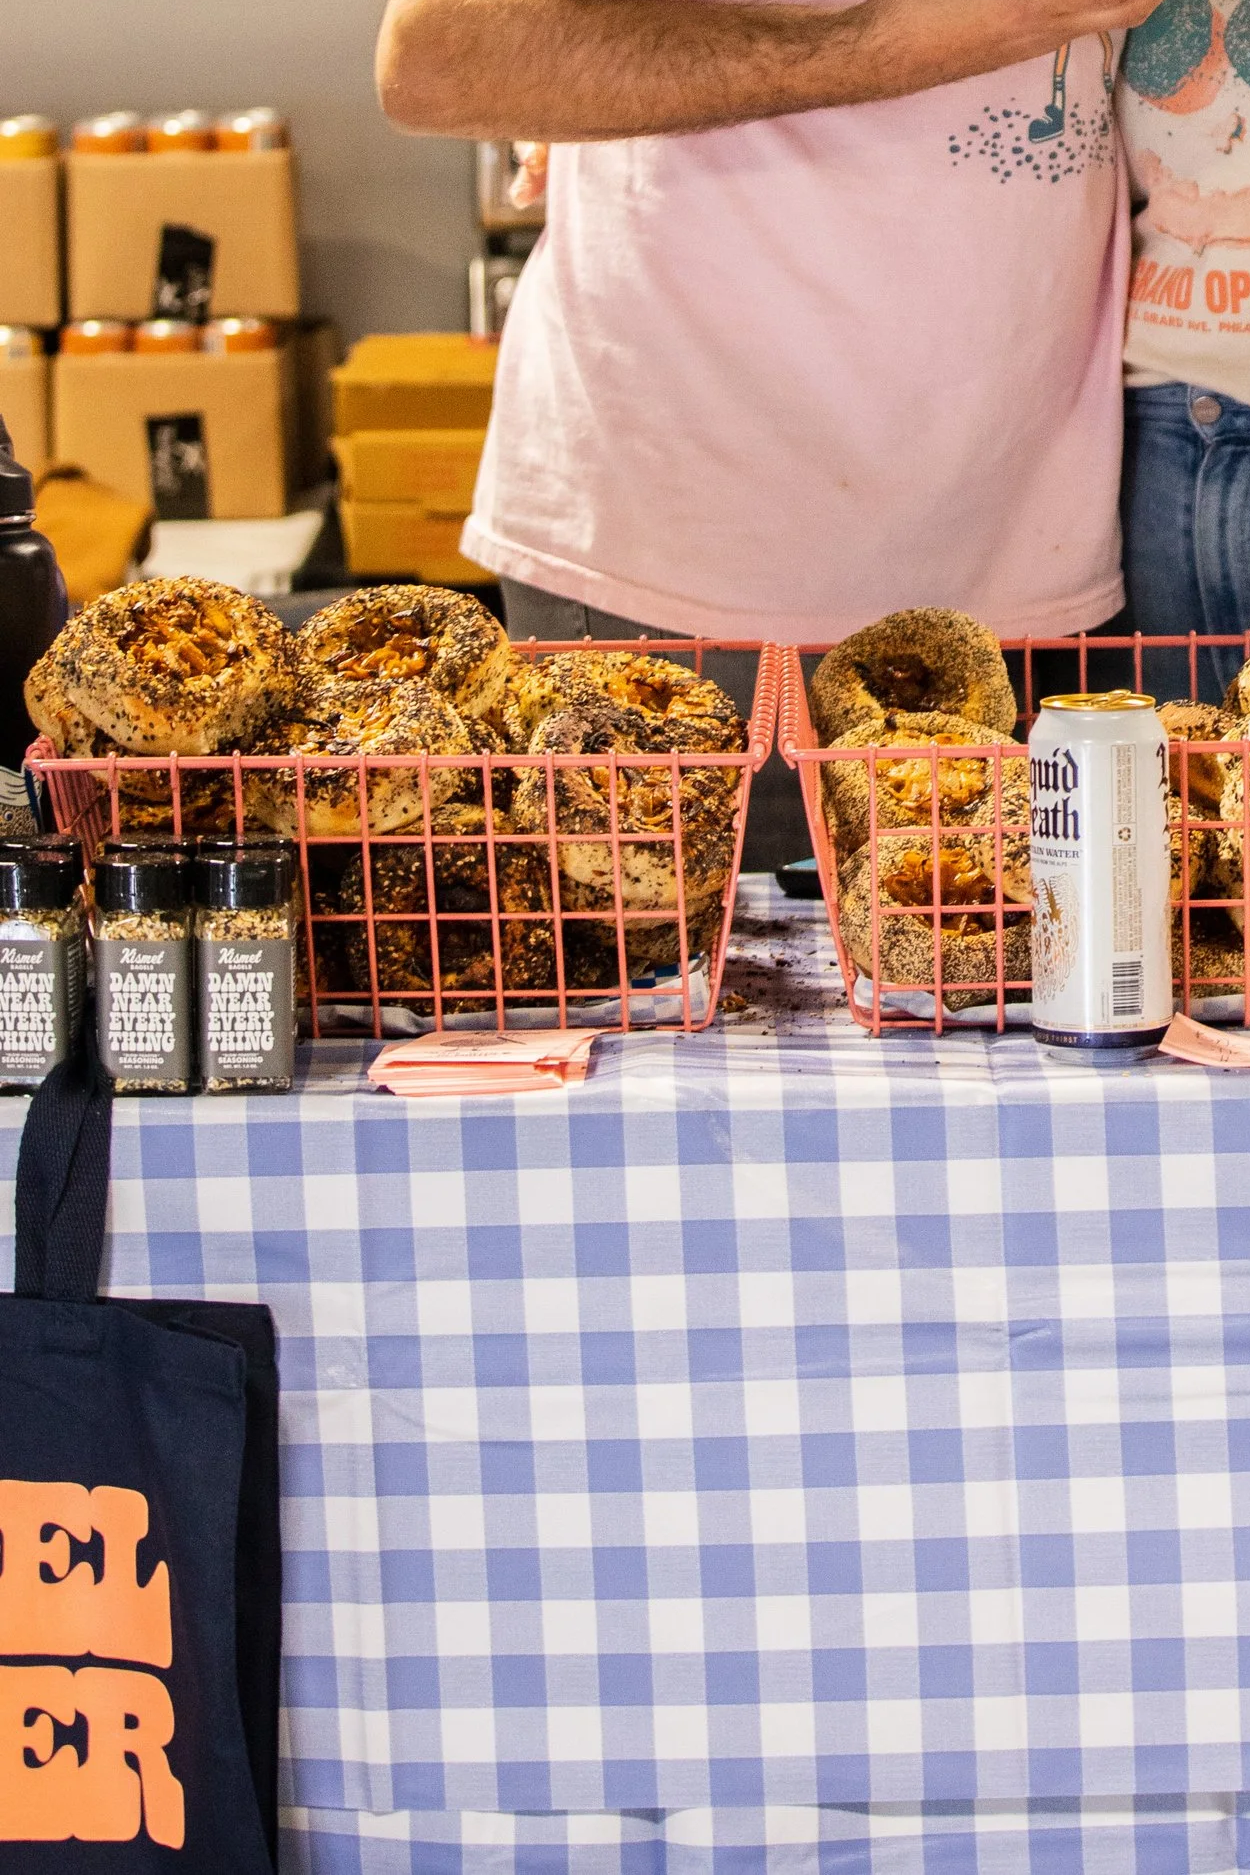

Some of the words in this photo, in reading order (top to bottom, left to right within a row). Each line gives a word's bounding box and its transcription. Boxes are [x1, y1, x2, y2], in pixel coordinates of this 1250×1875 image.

[1045, 848, 1080, 859] WATER
[1, 947, 44, 964] Kismet
[120, 947, 165, 965] Kismet
[218, 947, 263, 965] Kismet
[0, 972, 55, 993] AMN
[109, 972, 176, 993] DAMN
[208, 971, 274, 993] DAMN
[112, 992, 173, 1013] NEAR
[210, 991, 272, 1013] NEAR
[0, 1012, 57, 1032] VERY
[109, 1011, 176, 1032] EVERY
[208, 1010, 275, 1032] EVERY
[0, 1031, 57, 1052] HING
[108, 1031, 176, 1053] THING
[207, 1030, 275, 1052] THING
[1, 1056, 46, 1064] SEASONING
[119, 1057, 165, 1065] SEASONING
[218, 1056, 264, 1064] SEASONING
[0, 1479, 173, 1669] EL
